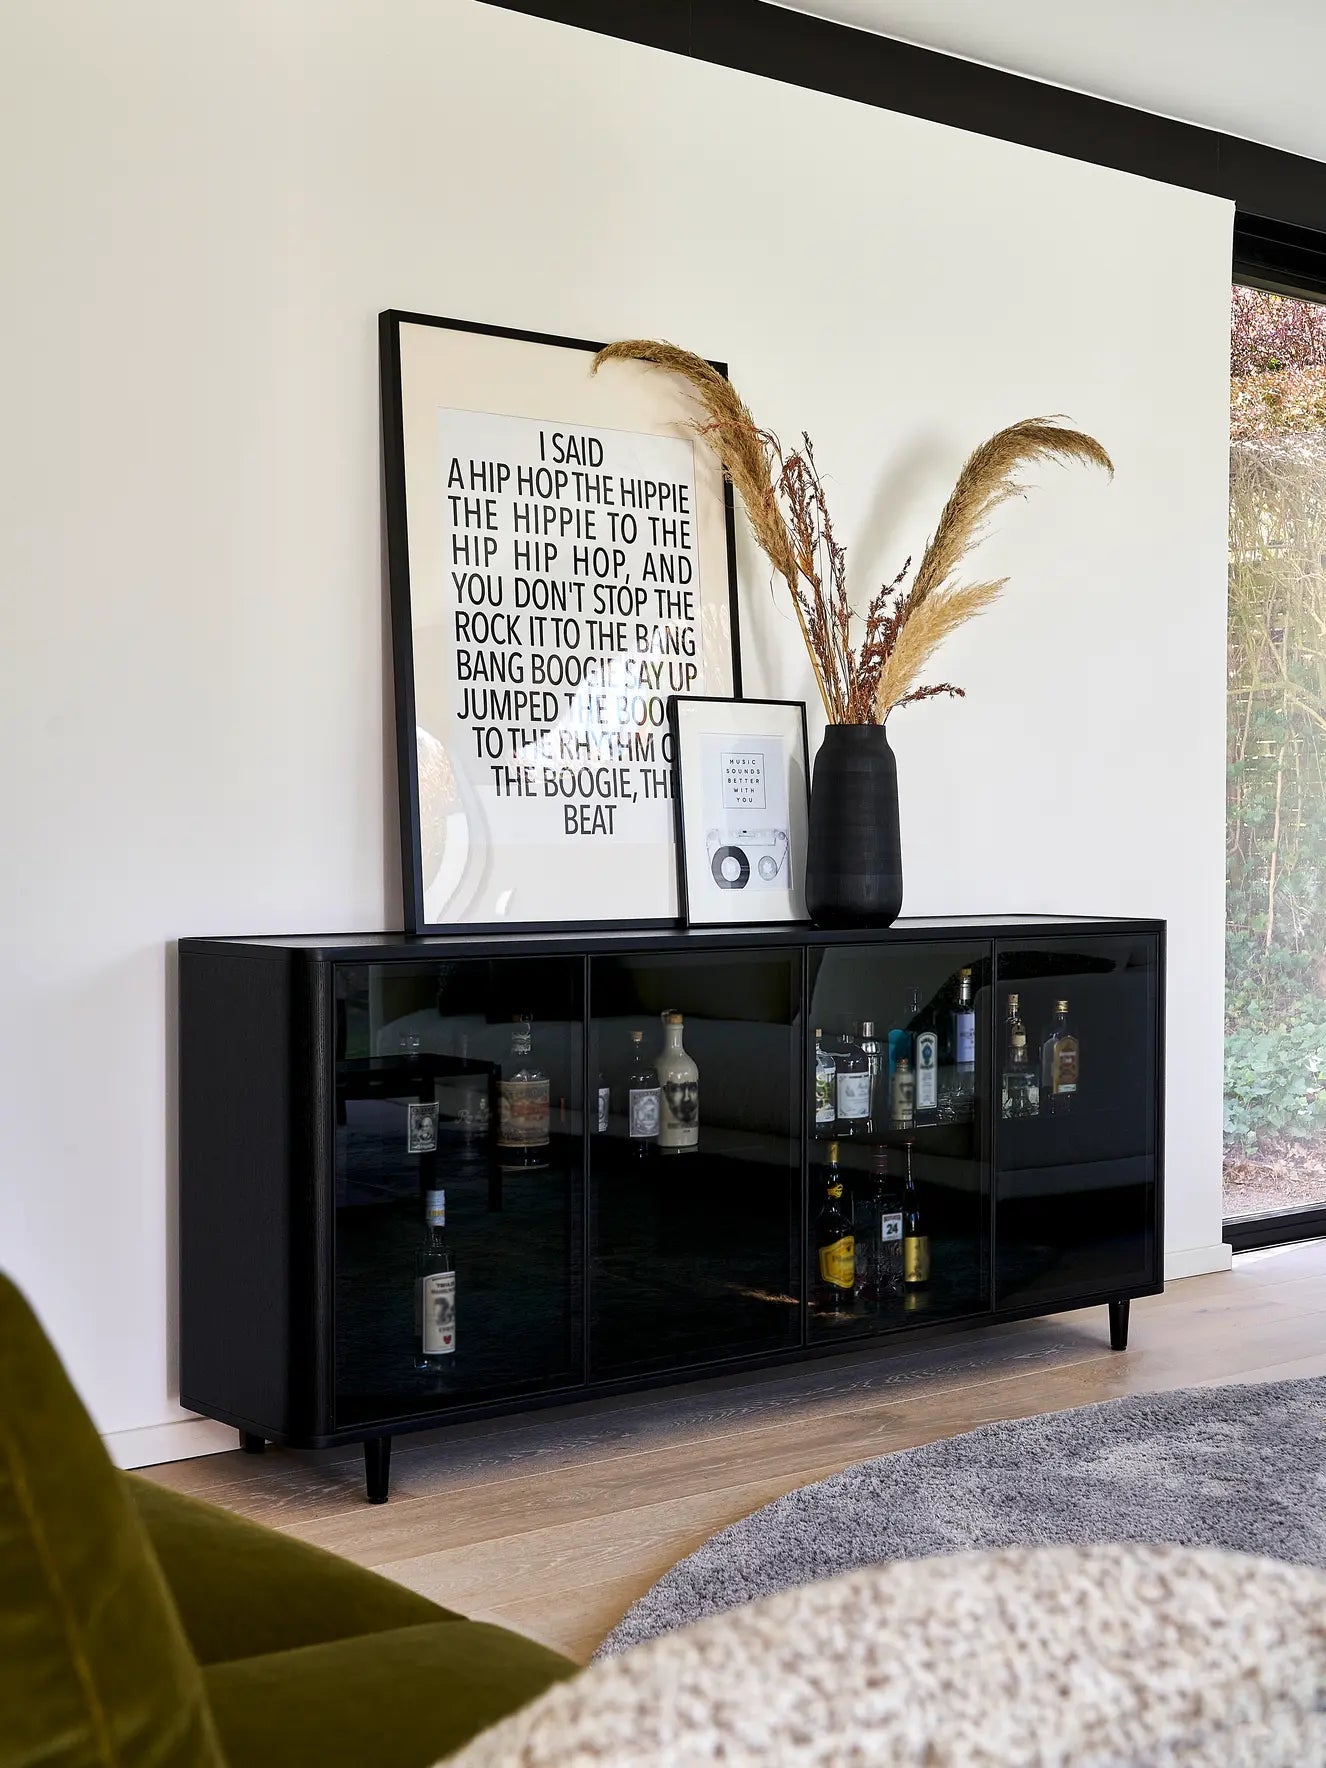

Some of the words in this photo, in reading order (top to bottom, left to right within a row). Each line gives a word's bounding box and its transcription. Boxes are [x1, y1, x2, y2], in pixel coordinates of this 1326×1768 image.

[539, 431, 545, 461] I
[552, 432, 604, 467] SAID
[447, 458, 465, 489] A
[470, 460, 511, 494] HIP
[517, 466, 569, 500] HOP
[571, 472, 615, 506] THE
[620, 477, 690, 514] HIPPIE
[447, 496, 498, 531] THE
[513, 502, 597, 540] HIPPIE
[607, 512, 637, 544] TO
[648, 516, 692, 550] THE
[452, 534, 498, 567] HIP
[514, 540, 558, 572] HIP
[573, 545, 630, 584] HOP,
[642, 552, 693, 585] AND
[451, 572, 503, 607] YOU
[514, 577, 585, 612] DON'T
[593, 583, 648, 617] STOP
[654, 589, 695, 621] THE
[455, 611, 523, 646] ROCK
[530, 616, 547, 646] IT
[551, 618, 580, 650] TO
[585, 620, 628, 652] THE
[636, 623, 696, 656] BANG
[457, 649, 524, 684] BANG
[532, 654, 620, 689] BOOGIE
[624, 659, 664, 691] SAY
[668, 661, 698, 692] UP
[457, 689, 558, 722] JUMPED
[564, 693, 607, 724] THE
[472, 727, 504, 759] TO
[507, 728, 552, 760] THE
[559, 729, 655, 762] RHYTHM
[661, 732, 675, 763] O
[490, 765, 537, 797] THE
[544, 766, 638, 804] BOOGIE,
[564, 804, 617, 835] BEAT
[887, 1223, 899, 1235] 24
